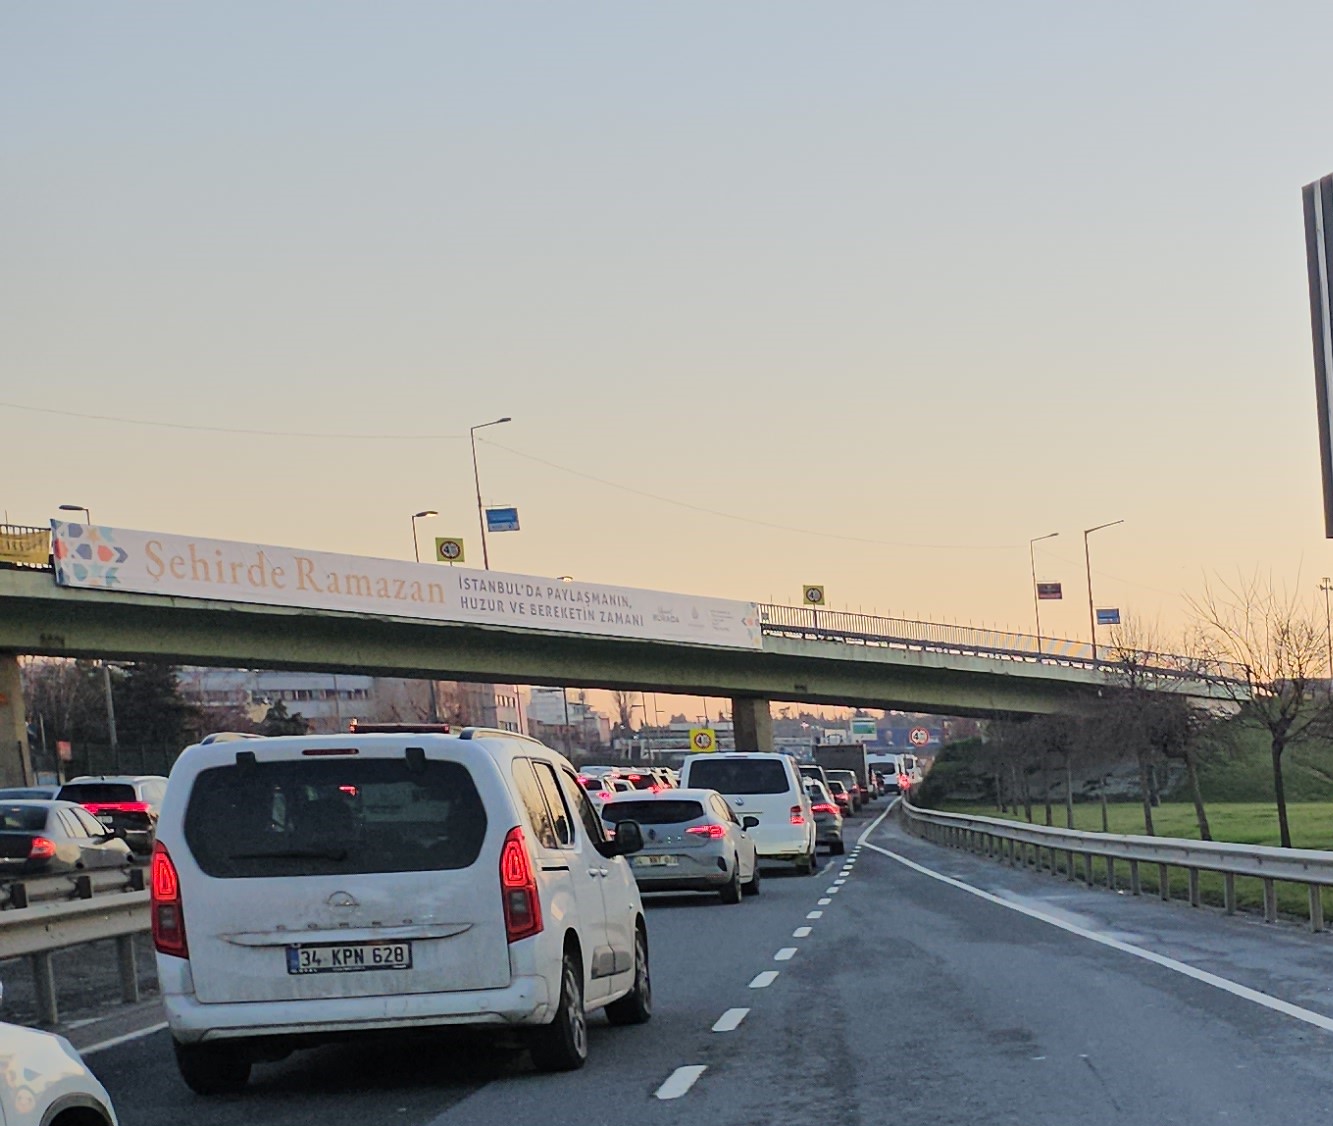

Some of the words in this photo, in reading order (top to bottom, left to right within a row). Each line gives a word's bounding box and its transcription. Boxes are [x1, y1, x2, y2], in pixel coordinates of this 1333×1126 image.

[144, 540, 287, 590] Şehirde
[294, 556, 447, 604] Ramazan
[461, 596, 505, 614] HUZUR
[510, 602, 526, 615] VE
[600, 611, 645, 627] ZAMANI
[300, 950, 319, 967] 34
[331, 948, 365, 966] KPN
[372, 946, 404, 963] 628
